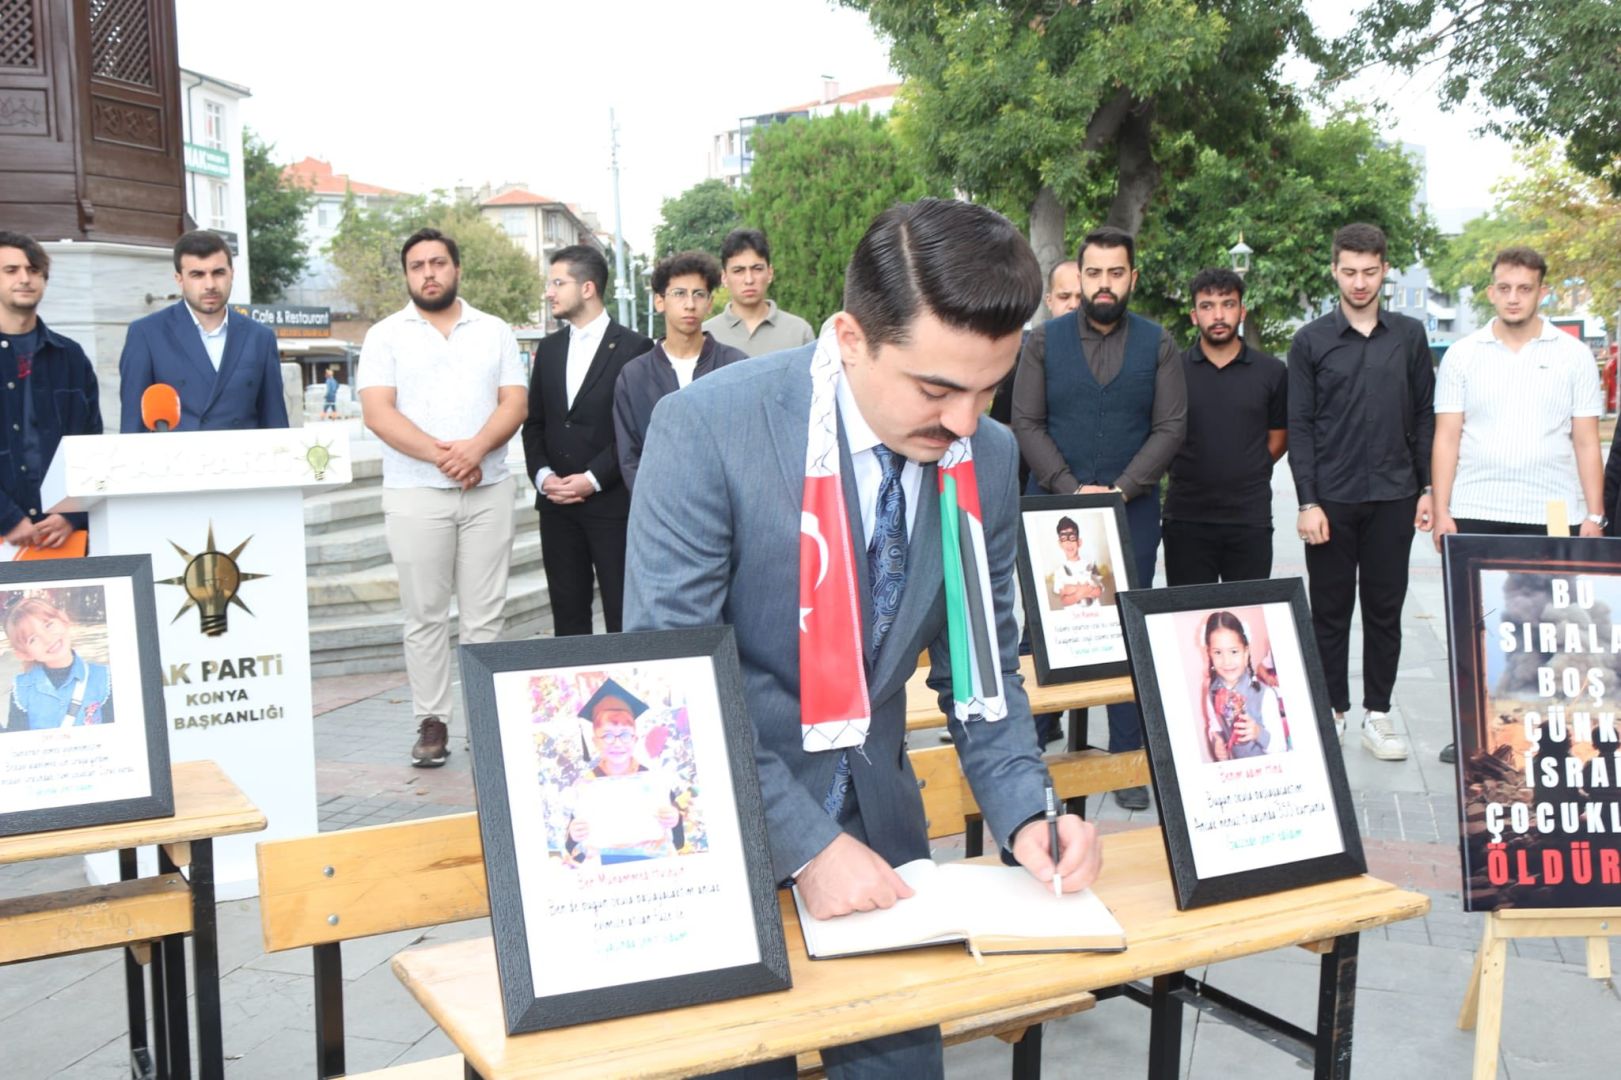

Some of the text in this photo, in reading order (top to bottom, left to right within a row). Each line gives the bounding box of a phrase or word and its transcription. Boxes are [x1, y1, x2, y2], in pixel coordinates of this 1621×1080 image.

[252, 309, 274, 323] Cafe
[277, 311, 283, 323] &
[285, 310, 329, 324] Restaurant
[1551, 578, 1595, 609] BU
[186, 689, 248, 706] KONYA
[1538, 667, 1605, 707] BOŞ
[174, 705, 284, 730] BAŞKANLIĞI
[1524, 705, 1619, 752] ÇÜNK
[1486, 802, 1621, 844] ÇOCUKL
[1487, 841, 1621, 886] ÖLDÜR
